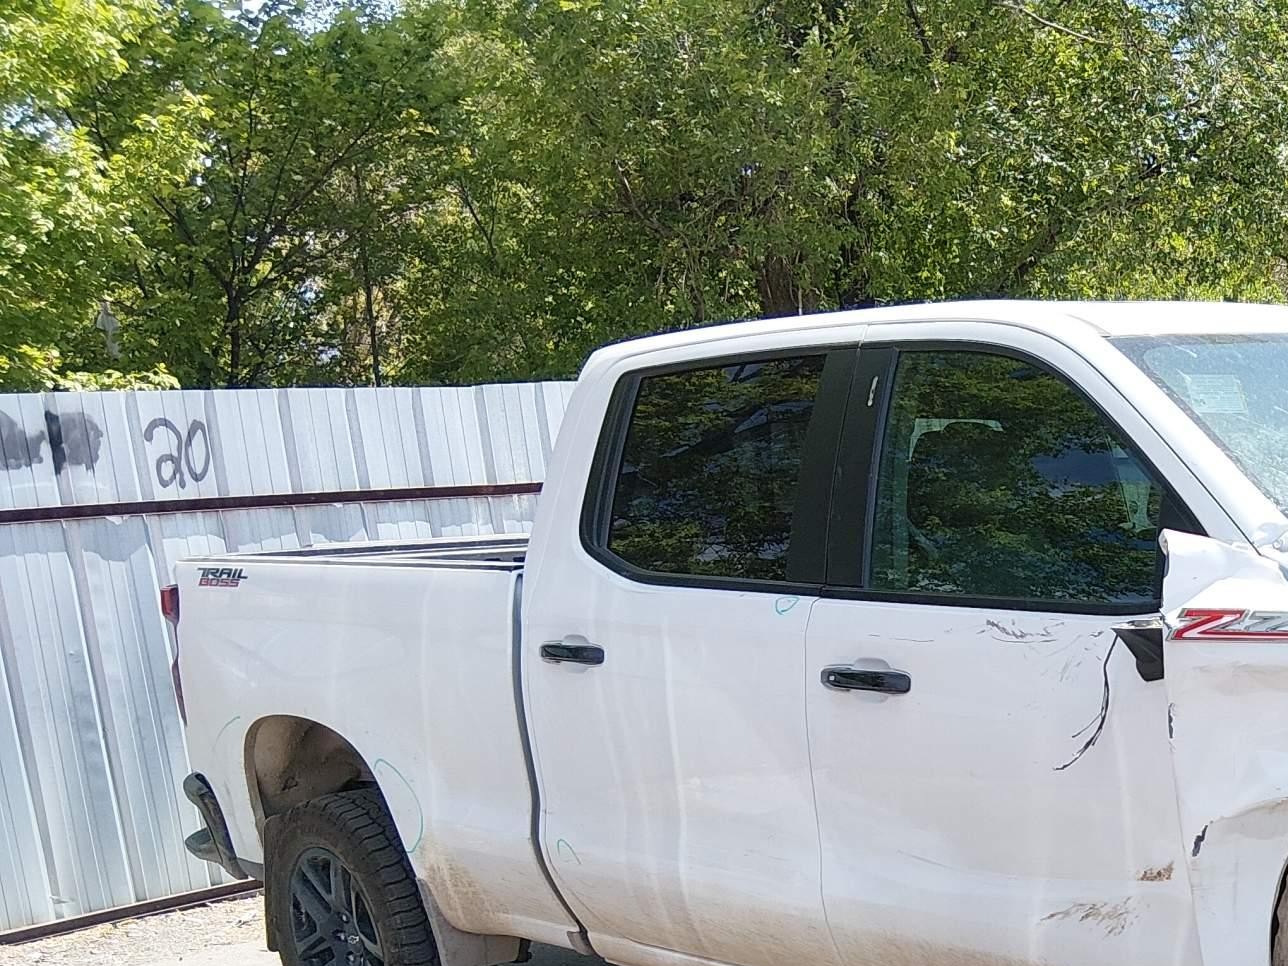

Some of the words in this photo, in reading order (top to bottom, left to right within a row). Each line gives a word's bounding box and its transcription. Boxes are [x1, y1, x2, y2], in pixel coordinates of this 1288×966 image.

[144, 417, 211, 489] 20
[197, 567, 248, 579] TRAIL
[198, 577, 241, 587] BOSS
